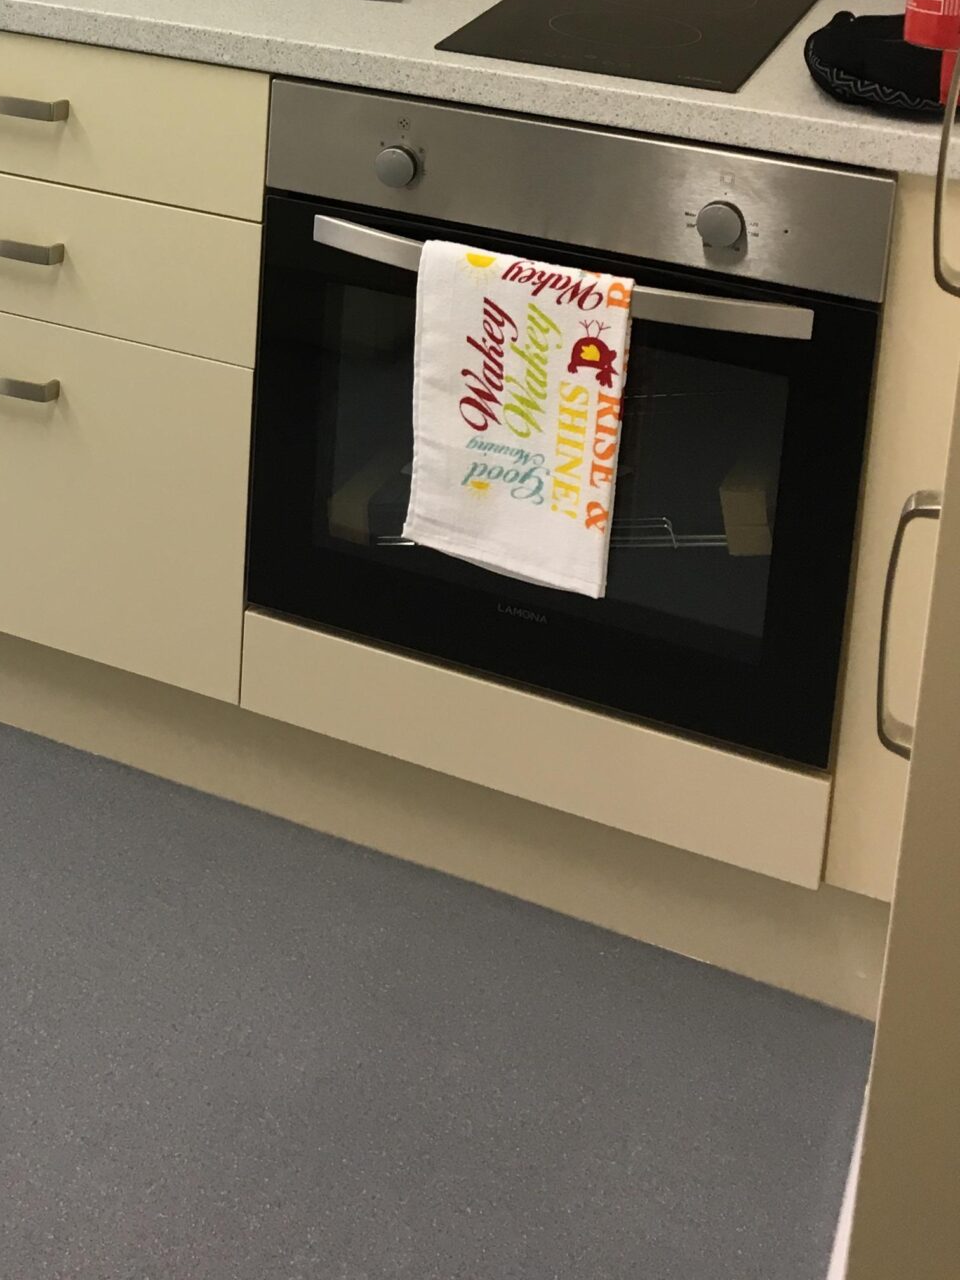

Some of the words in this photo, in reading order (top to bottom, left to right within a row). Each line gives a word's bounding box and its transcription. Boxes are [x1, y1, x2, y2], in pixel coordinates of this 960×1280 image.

[501, 260, 603, 311] Wakey
[459, 296, 519, 432] Wakey
[502, 302, 562, 438] Wakey
[465, 433, 546, 467] Morning
[550, 380, 589, 520] SHINE!
[589, 390, 622, 488] RISE
[460, 460, 551, 506] Good
[496, 602, 548, 625] LAMONA
